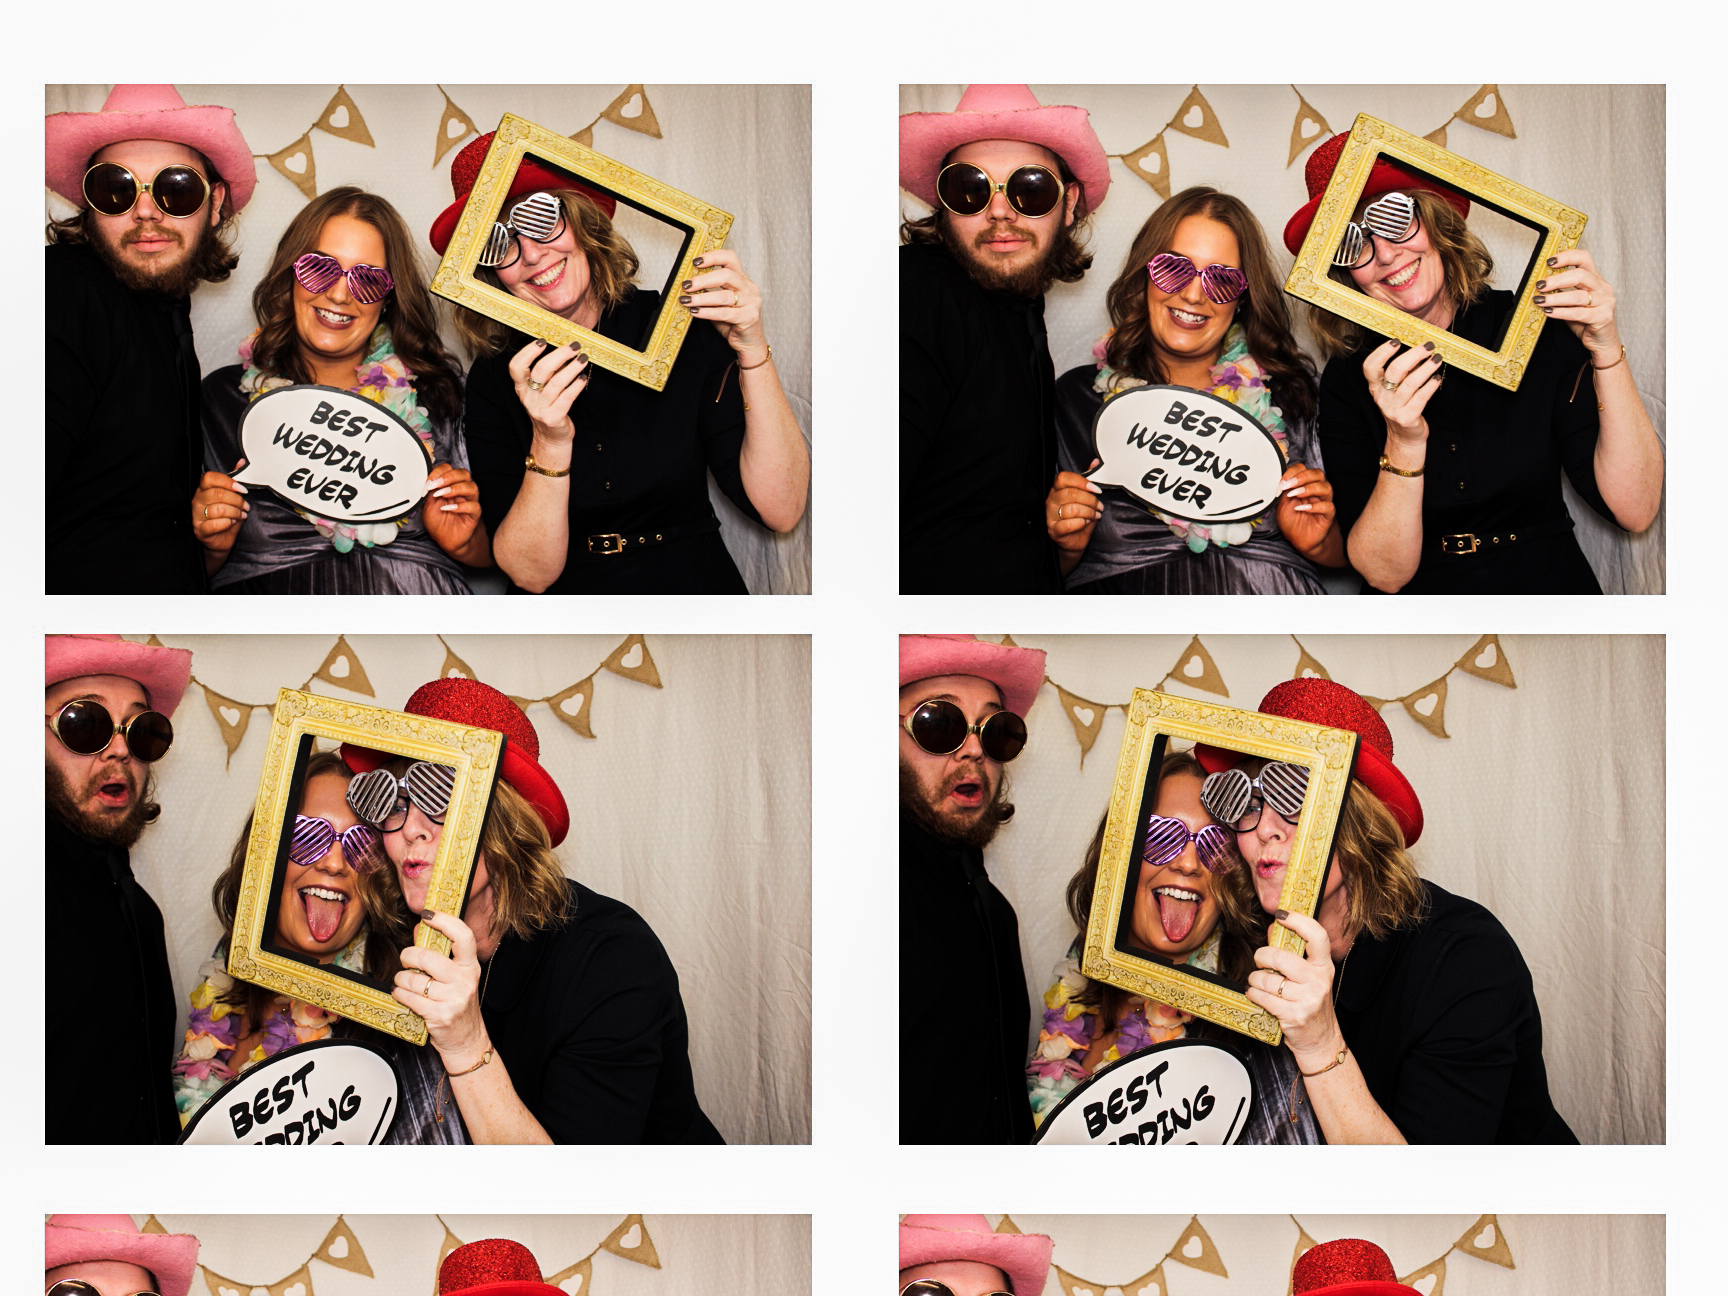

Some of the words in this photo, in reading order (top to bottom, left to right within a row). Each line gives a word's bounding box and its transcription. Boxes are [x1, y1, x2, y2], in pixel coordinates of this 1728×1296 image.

[309, 400, 389, 443] BEST
[1163, 400, 1243, 443] BEST
[272, 422, 397, 485] WEDDING
[1126, 422, 1251, 485] WEDDING
[286, 467, 358, 510] EVER
[1140, 467, 1212, 510] EVER
[229, 1060, 315, 1139] BEST
[1083, 1060, 1169, 1139] BEST
